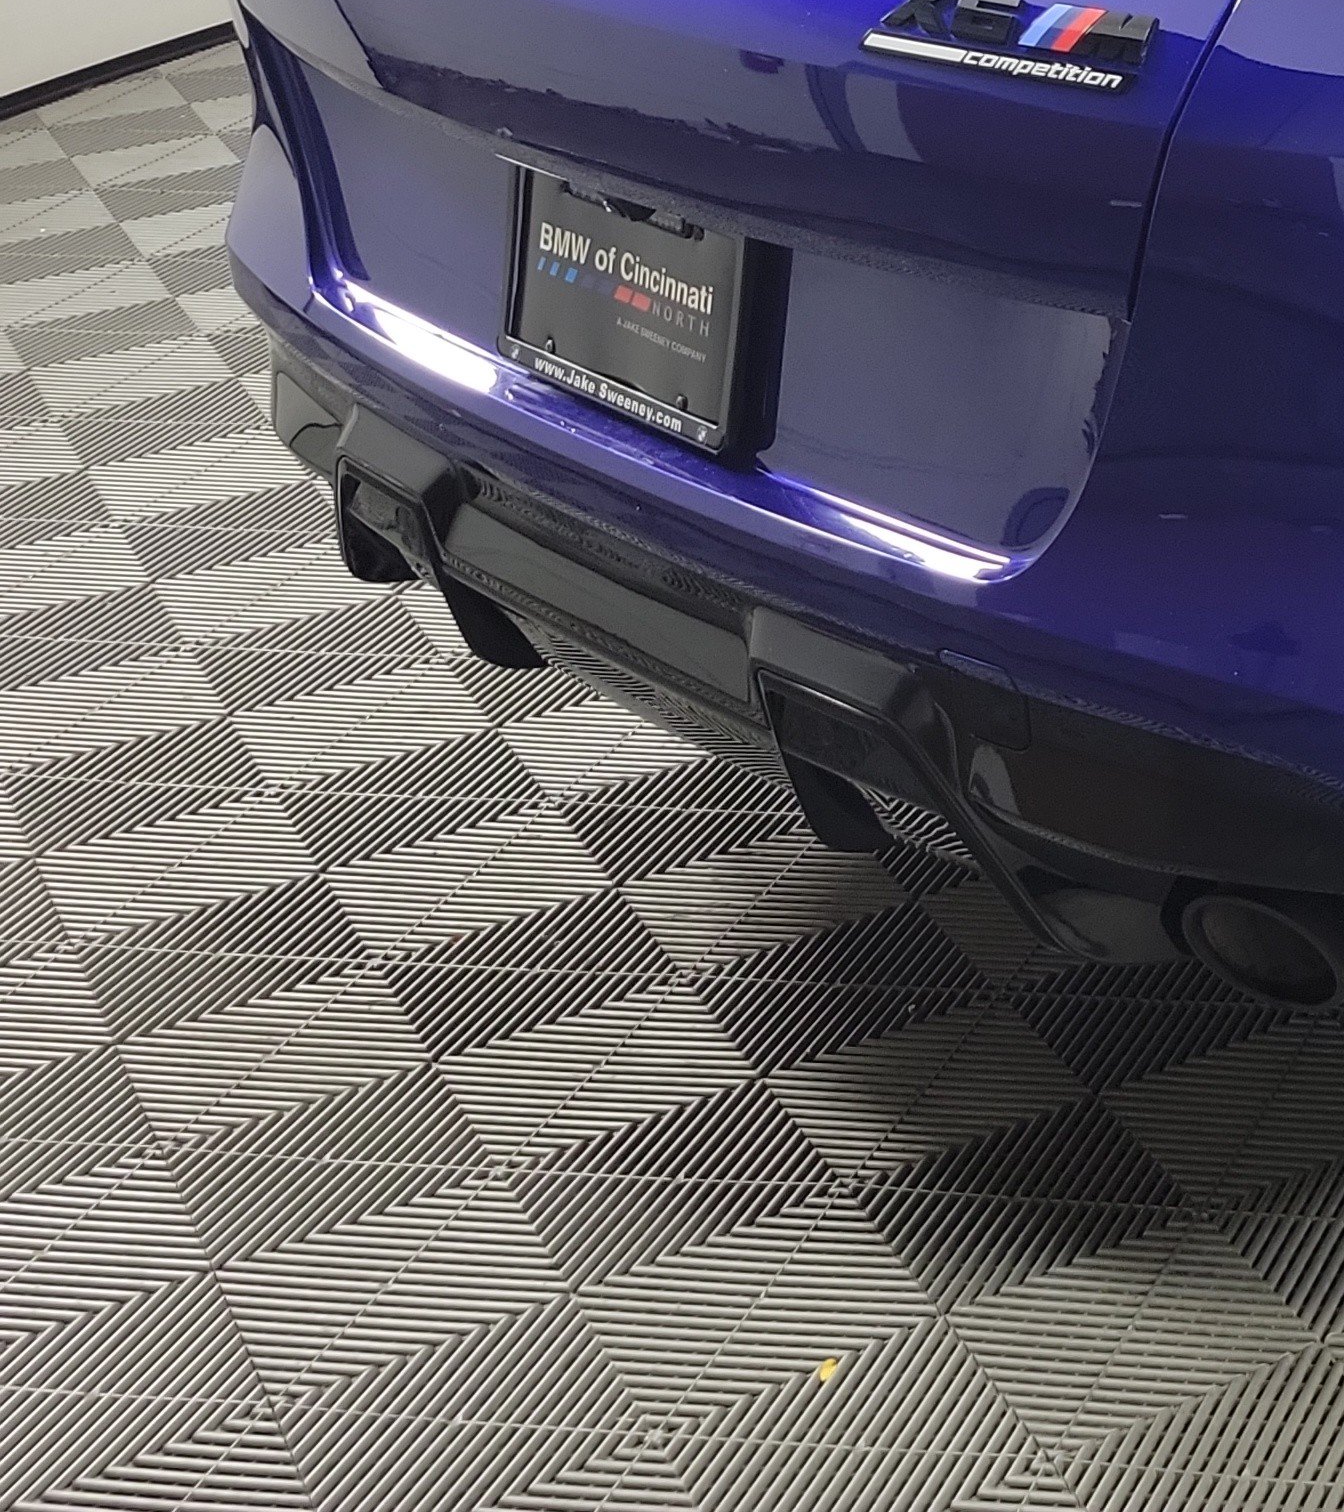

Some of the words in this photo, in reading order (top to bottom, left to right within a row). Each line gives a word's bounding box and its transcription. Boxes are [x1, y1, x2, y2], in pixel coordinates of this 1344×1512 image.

[963, 50, 1123, 89] competition
[539, 222, 591, 265] BMW
[594, 246, 617, 275] of
[620, 251, 714, 315] Cincinnati
[651, 300, 710, 338] NORTH
[671, 341, 706, 364] COMPANY
[534, 357, 596, 394] www.Jake
[598, 382, 682, 433] Sweeney.com
